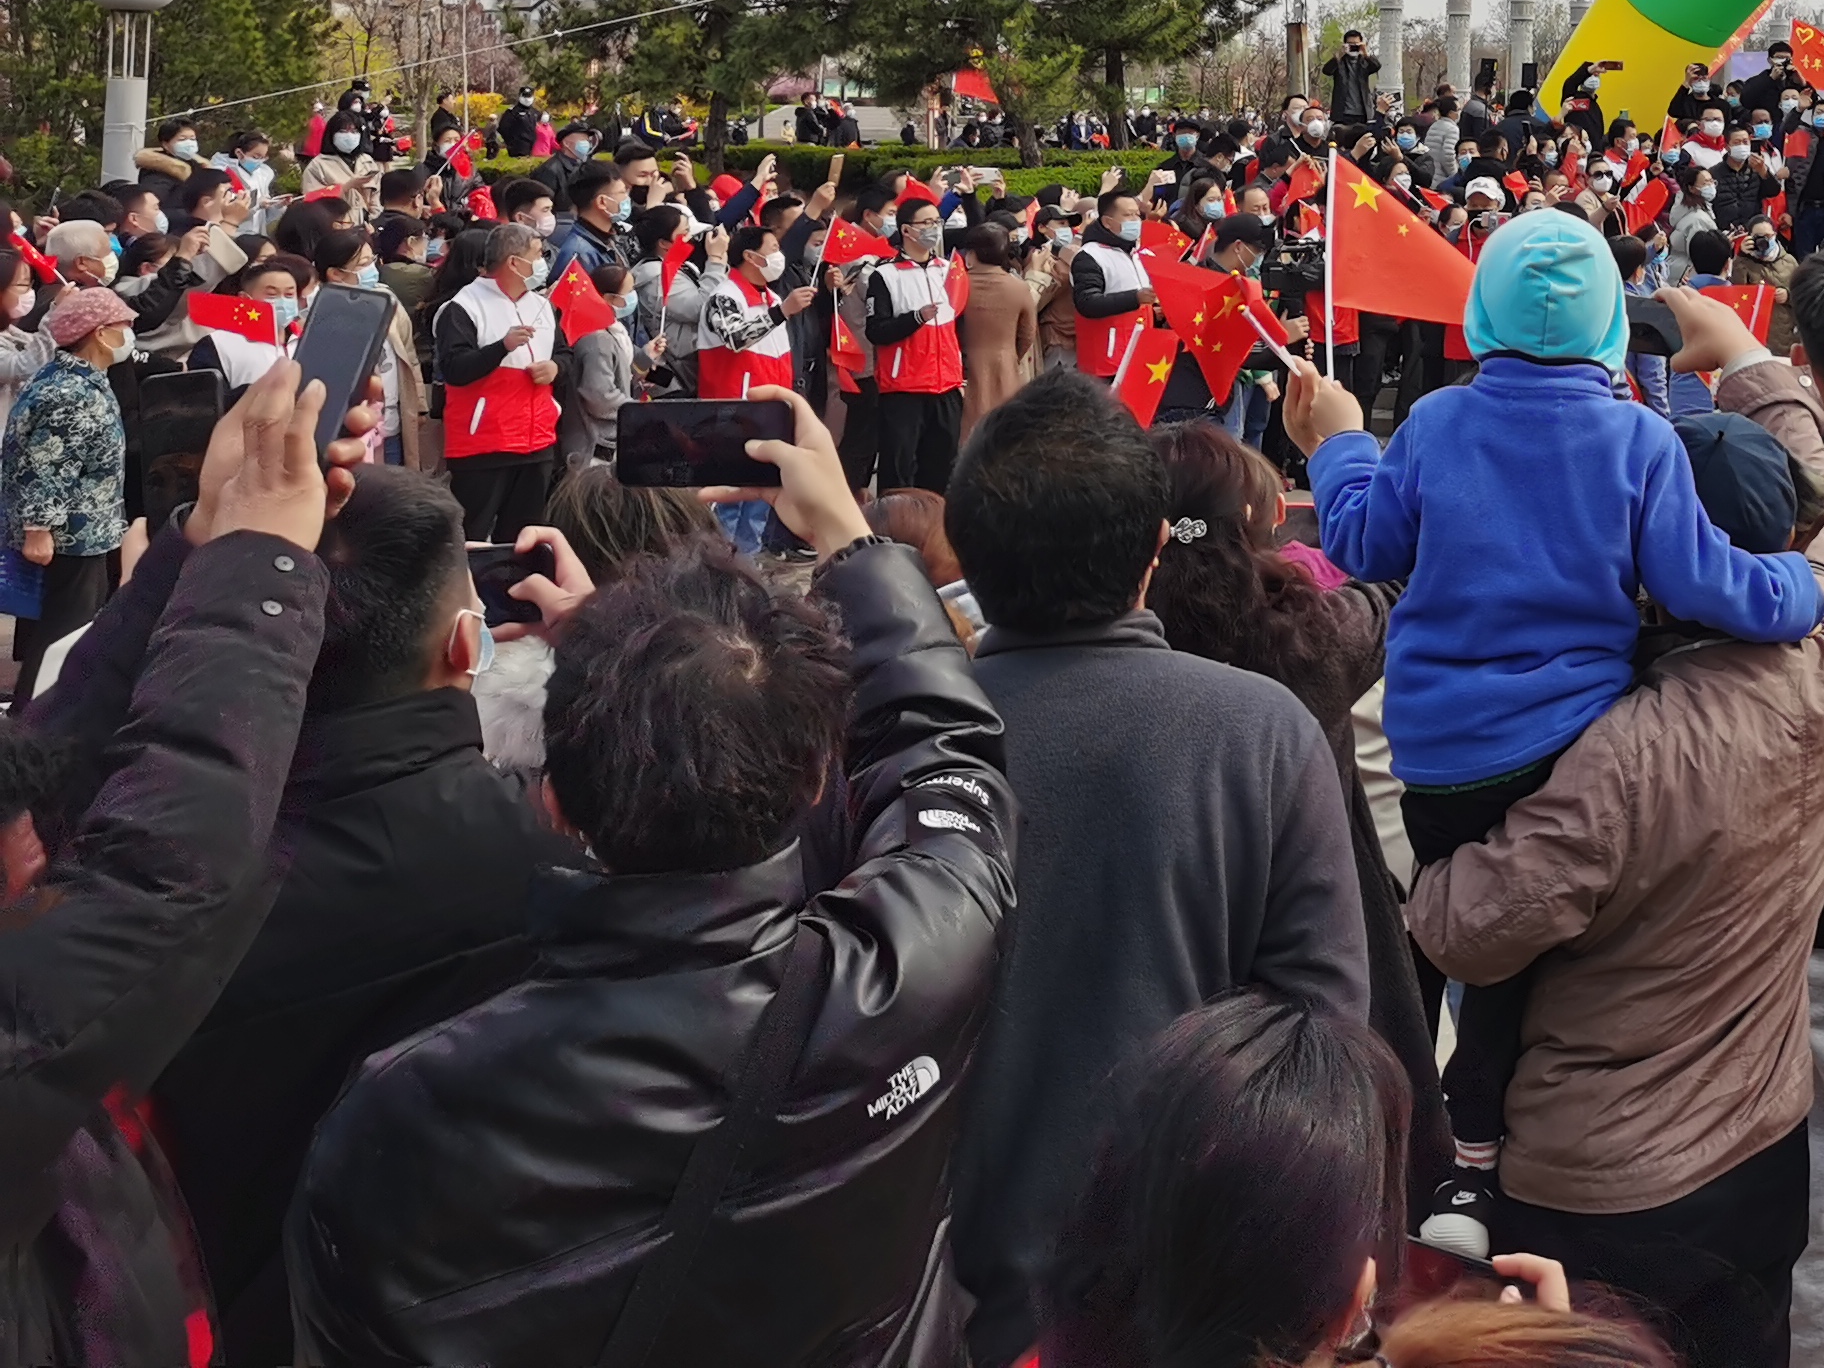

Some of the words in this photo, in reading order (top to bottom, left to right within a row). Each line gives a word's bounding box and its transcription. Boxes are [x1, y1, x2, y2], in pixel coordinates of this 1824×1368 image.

[886, 1061, 915, 1089] THE
[866, 1073, 918, 1119] MIDDLE
[885, 1085, 921, 1121] ADV.
